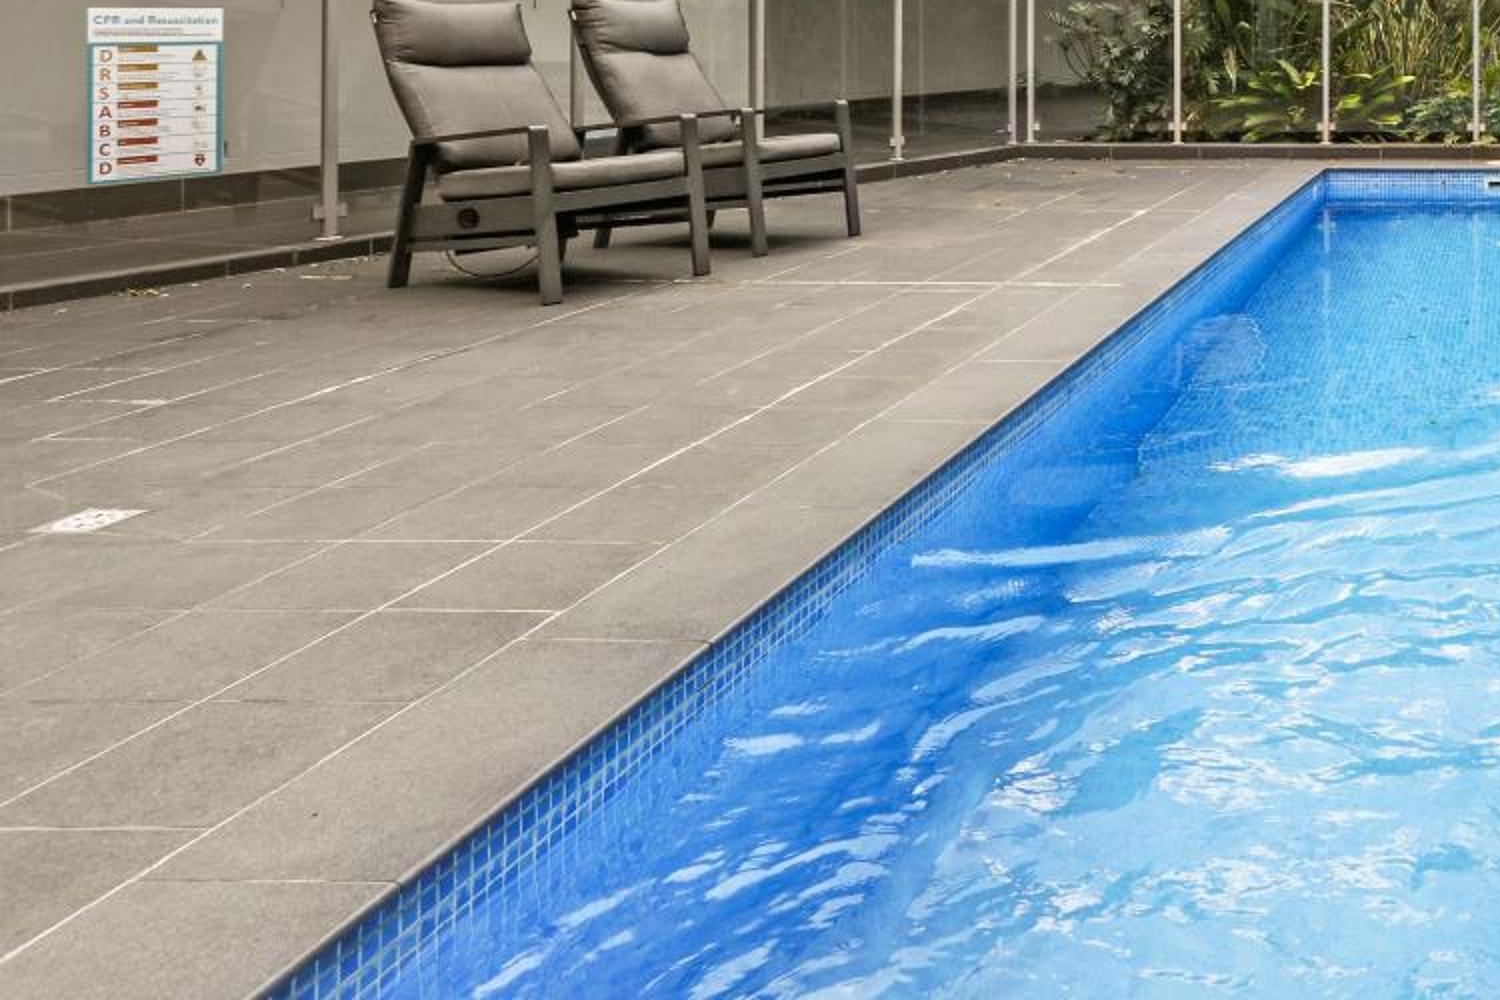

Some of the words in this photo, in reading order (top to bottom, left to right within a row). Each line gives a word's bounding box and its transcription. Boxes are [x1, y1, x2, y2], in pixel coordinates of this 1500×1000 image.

[100, 50, 112, 62] D
[100, 68, 111, 81] R
[99, 87, 110, 100] S
[99, 106, 112, 118] A
[100, 125, 111, 137] B
[100, 143, 111, 156] C
[100, 162, 112, 175] D
